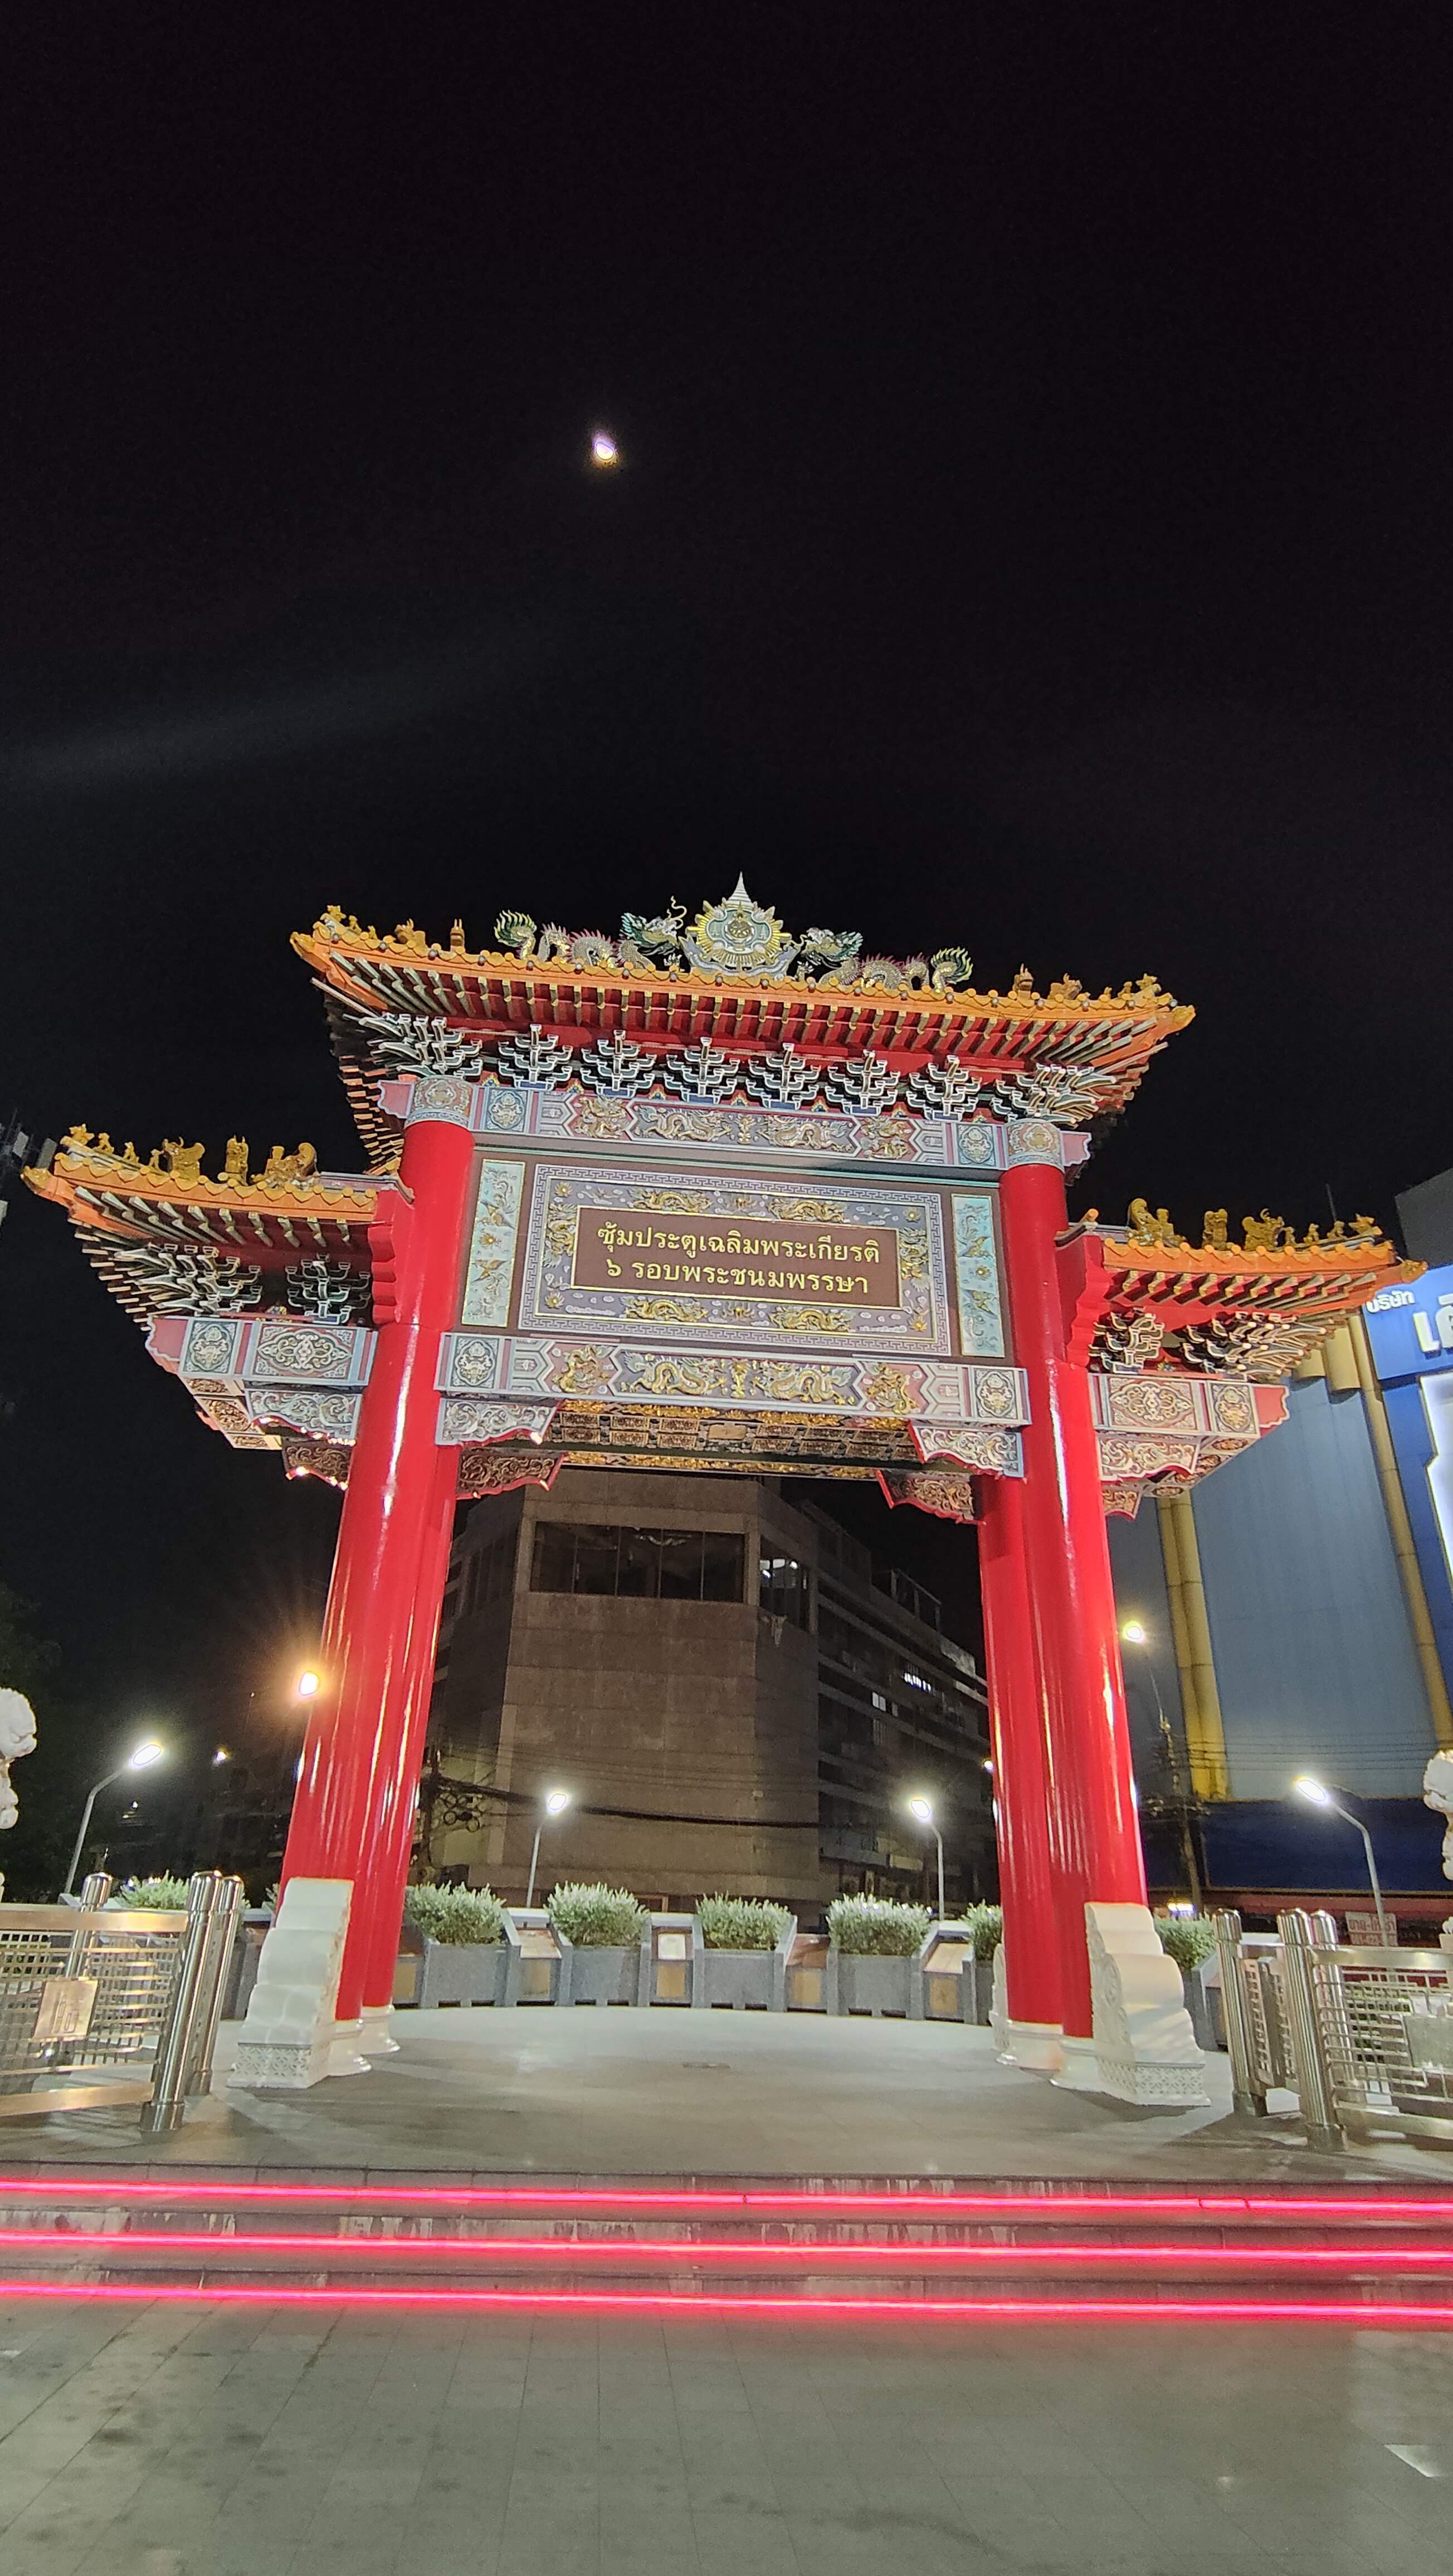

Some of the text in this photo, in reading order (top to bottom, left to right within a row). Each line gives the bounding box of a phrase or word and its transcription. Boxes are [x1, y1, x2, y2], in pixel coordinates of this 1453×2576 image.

[597, 1221, 880, 1263] ซุ้มประตูเฉลิมพระเกียรติ
[606, 1258, 868, 1294] ๖ รอบพระชนมพรรษา
[1366, 1290, 1415, 1313] บริษัท
